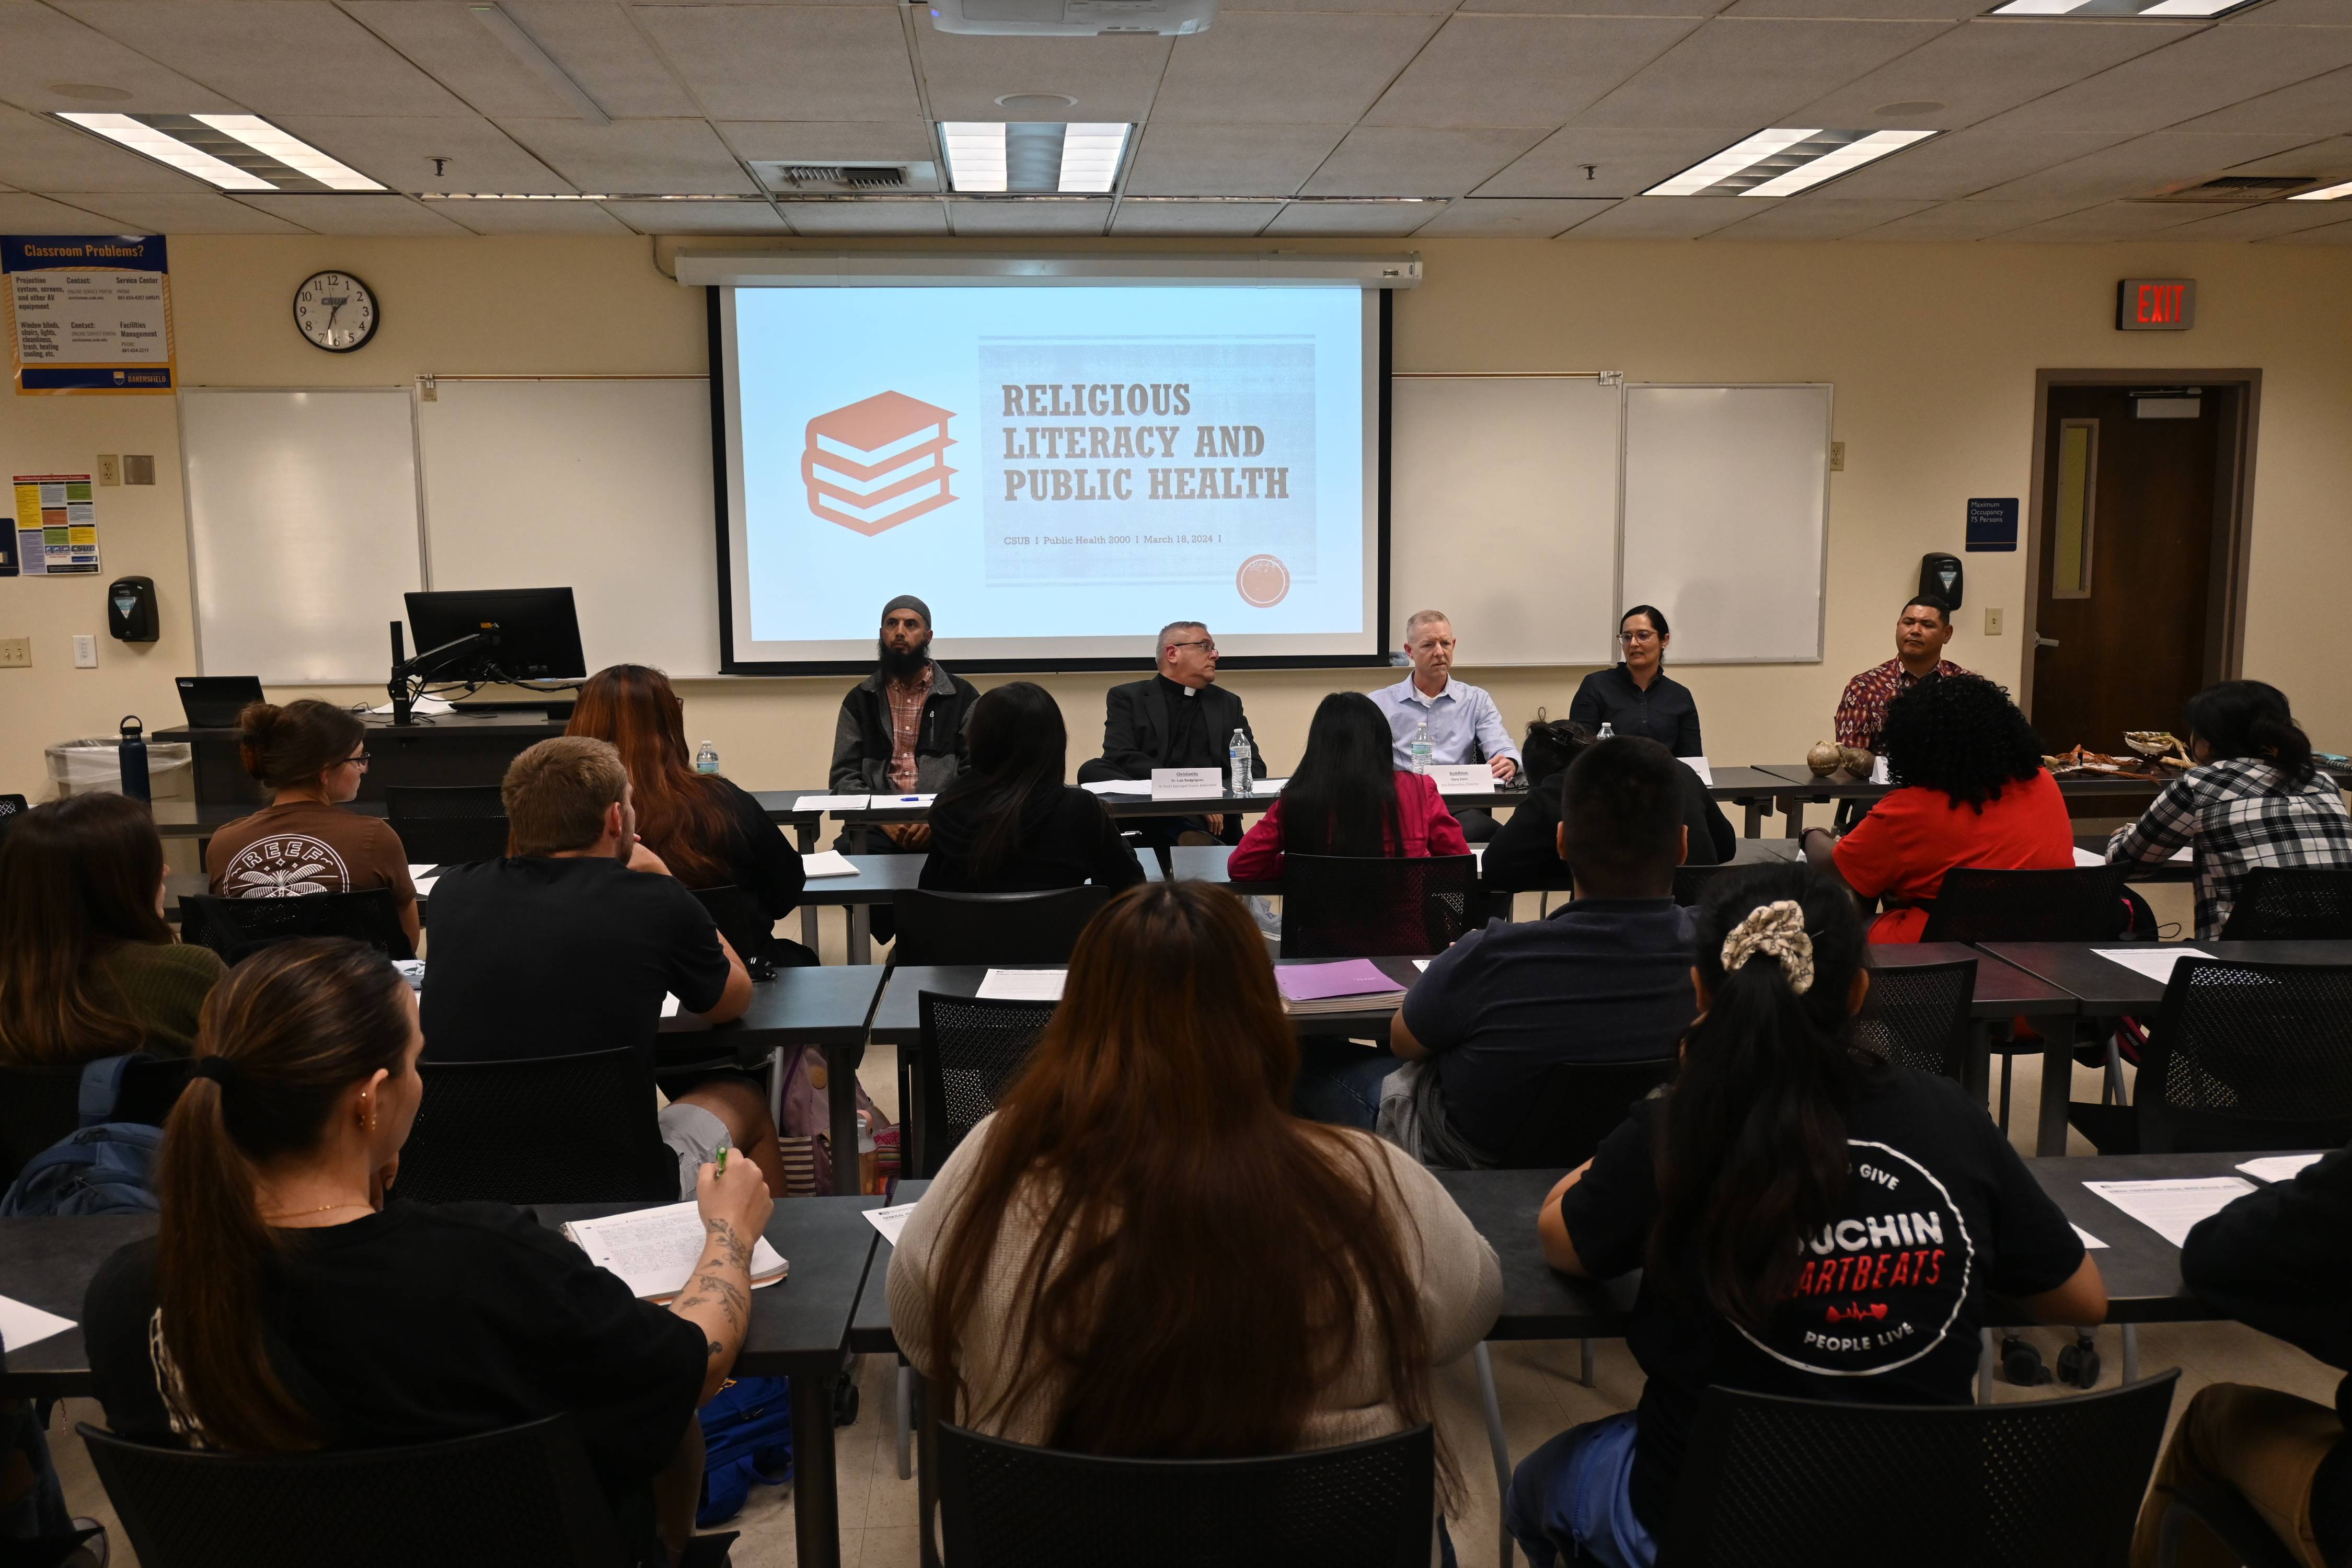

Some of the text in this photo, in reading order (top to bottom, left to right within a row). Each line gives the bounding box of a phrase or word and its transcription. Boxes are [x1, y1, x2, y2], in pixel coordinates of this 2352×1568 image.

[25, 245, 144, 257] Classroom Problems?
[327, 275, 339, 285] 12
[345, 281, 350, 290] 1
[314, 281, 322, 291] 11
[302, 291, 312, 302] 10
[356, 291, 363, 302] 2
[2137, 285, 2185, 322] EXIT
[300, 306, 306, 317] 9
[363, 306, 369, 317] 3
[305, 321, 313, 331] 8
[359, 321, 365, 331] 4
[318, 333, 325, 343] 7
[333, 336, 340, 347] 6
[349, 333, 354, 343] 5
[1002, 384, 1191, 417] RELIGIOUS
[1002, 425, 1265, 459] LITERACY AND
[1004, 467, 1289, 501] PUBLIC HEALTH
[1043, 536, 1073, 545] Public
[1144, 535, 1173, 543] March
[1176, 535, 1190, 544] 18,
[1191, 535, 1213, 543] 2024
[242, 841, 324, 868] REEF
[1860, 1163, 1899, 1191] GIVE
[1798, 1211, 1944, 1255] UCHIN
[1793, 1249, 1946, 1298] ARTBEATS
[1804, 1322, 1914, 1352] PEOPLE LIVE
